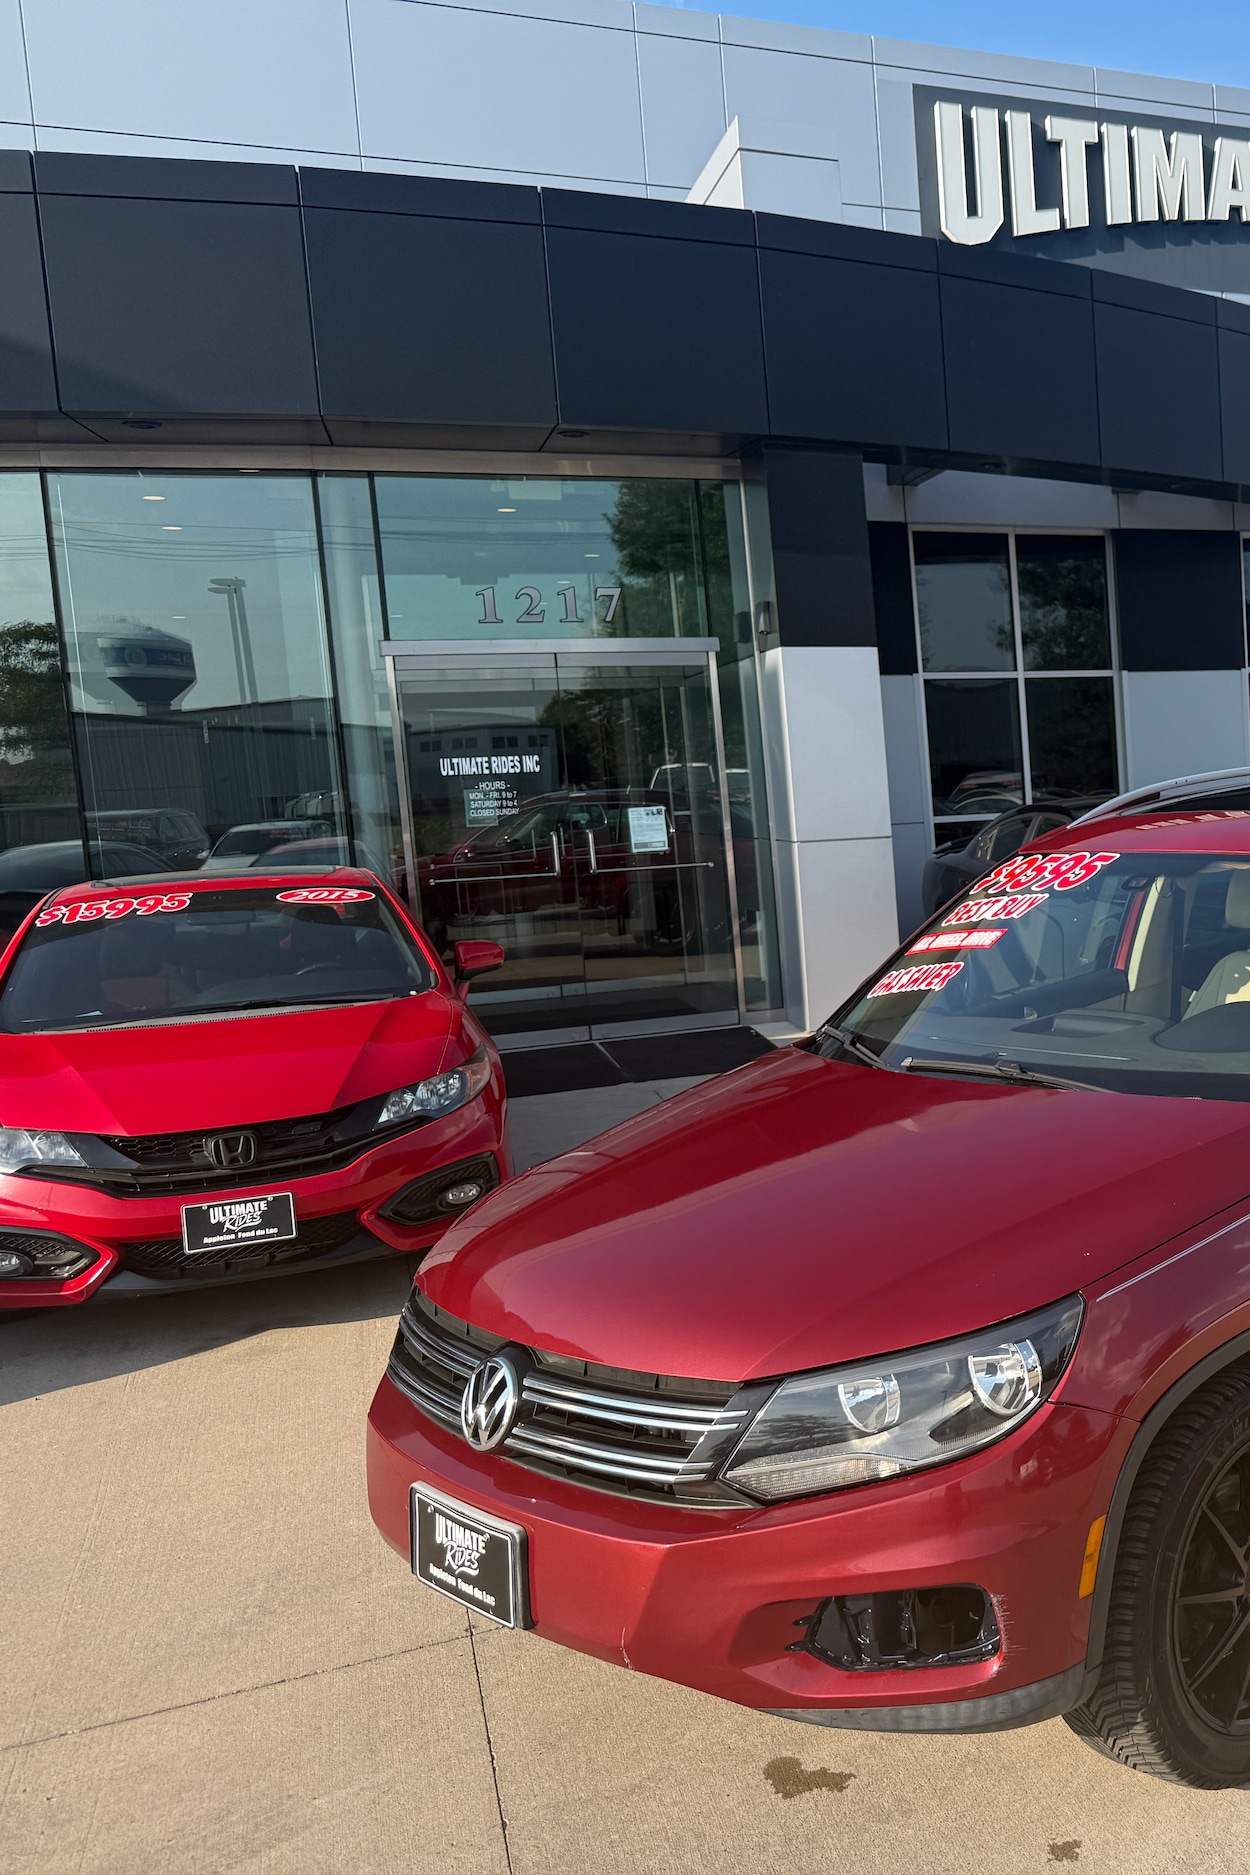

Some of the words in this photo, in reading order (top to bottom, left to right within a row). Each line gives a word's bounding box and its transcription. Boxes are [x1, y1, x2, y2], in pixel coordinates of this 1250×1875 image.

[475, 586, 622, 623] 1217
[439, 756, 490, 776] ULTIMATE
[491, 755, 521, 774] RIDES
[522, 754, 541, 773] INC
[479, 781, 506, 790] HOURS
[469, 808, 495, 817] CLOSED
[495, 807, 520, 816] SUNDAY
[470, 800, 501, 808] SATURDAY
[969, 852, 1121, 895] $9595
[287, 890, 361, 901] 2015
[35, 892, 193, 927] $15995
[942, 896, 1006, 926] BEST
[989, 893, 1049, 919] BUY
[209, 1200, 268, 1225] ULTIMATE
[203, 1232, 236, 1244] Appleton
[238, 1229, 255, 1239] Fond
[435, 1512, 487, 1555] ULTIMATE
